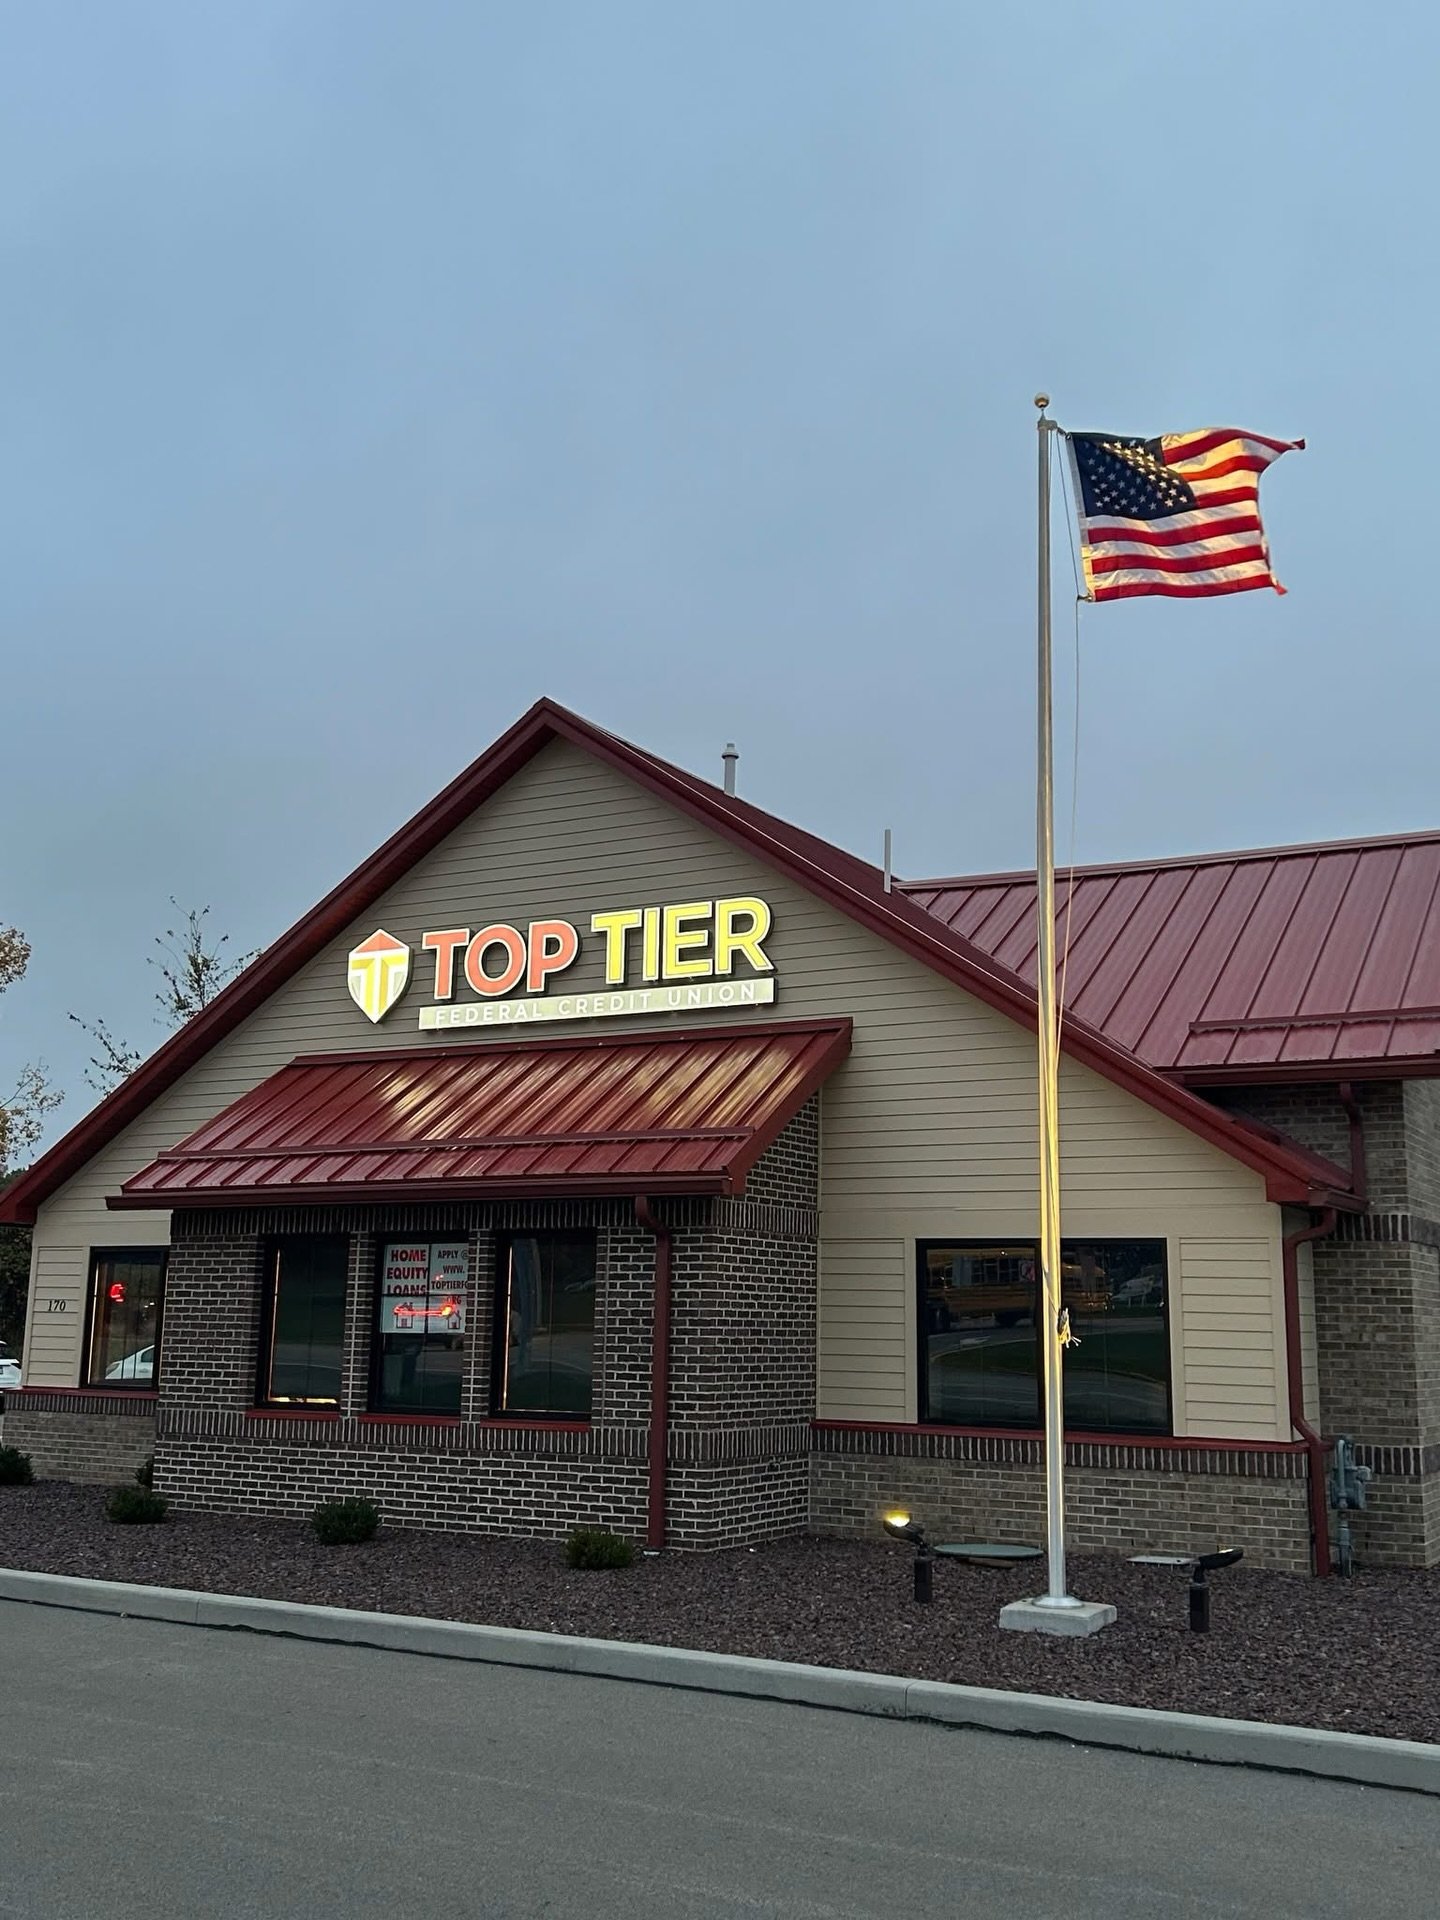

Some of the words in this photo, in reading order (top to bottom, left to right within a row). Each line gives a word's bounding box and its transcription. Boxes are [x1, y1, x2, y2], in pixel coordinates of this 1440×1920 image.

[422, 919, 580, 1000] TOP
[591, 896, 775, 985] TIER
[435, 1003, 543, 1026] FEDERAL
[558, 992, 652, 1016] CREDIT
[668, 982, 755, 1007] UNION
[390, 1249, 427, 1262] HOME
[437, 1250, 459, 1259] APPLY
[386, 1267, 428, 1279] EQUITY
[387, 1284, 427, 1297] LOANS
[48, 1299, 66, 1312] 170
